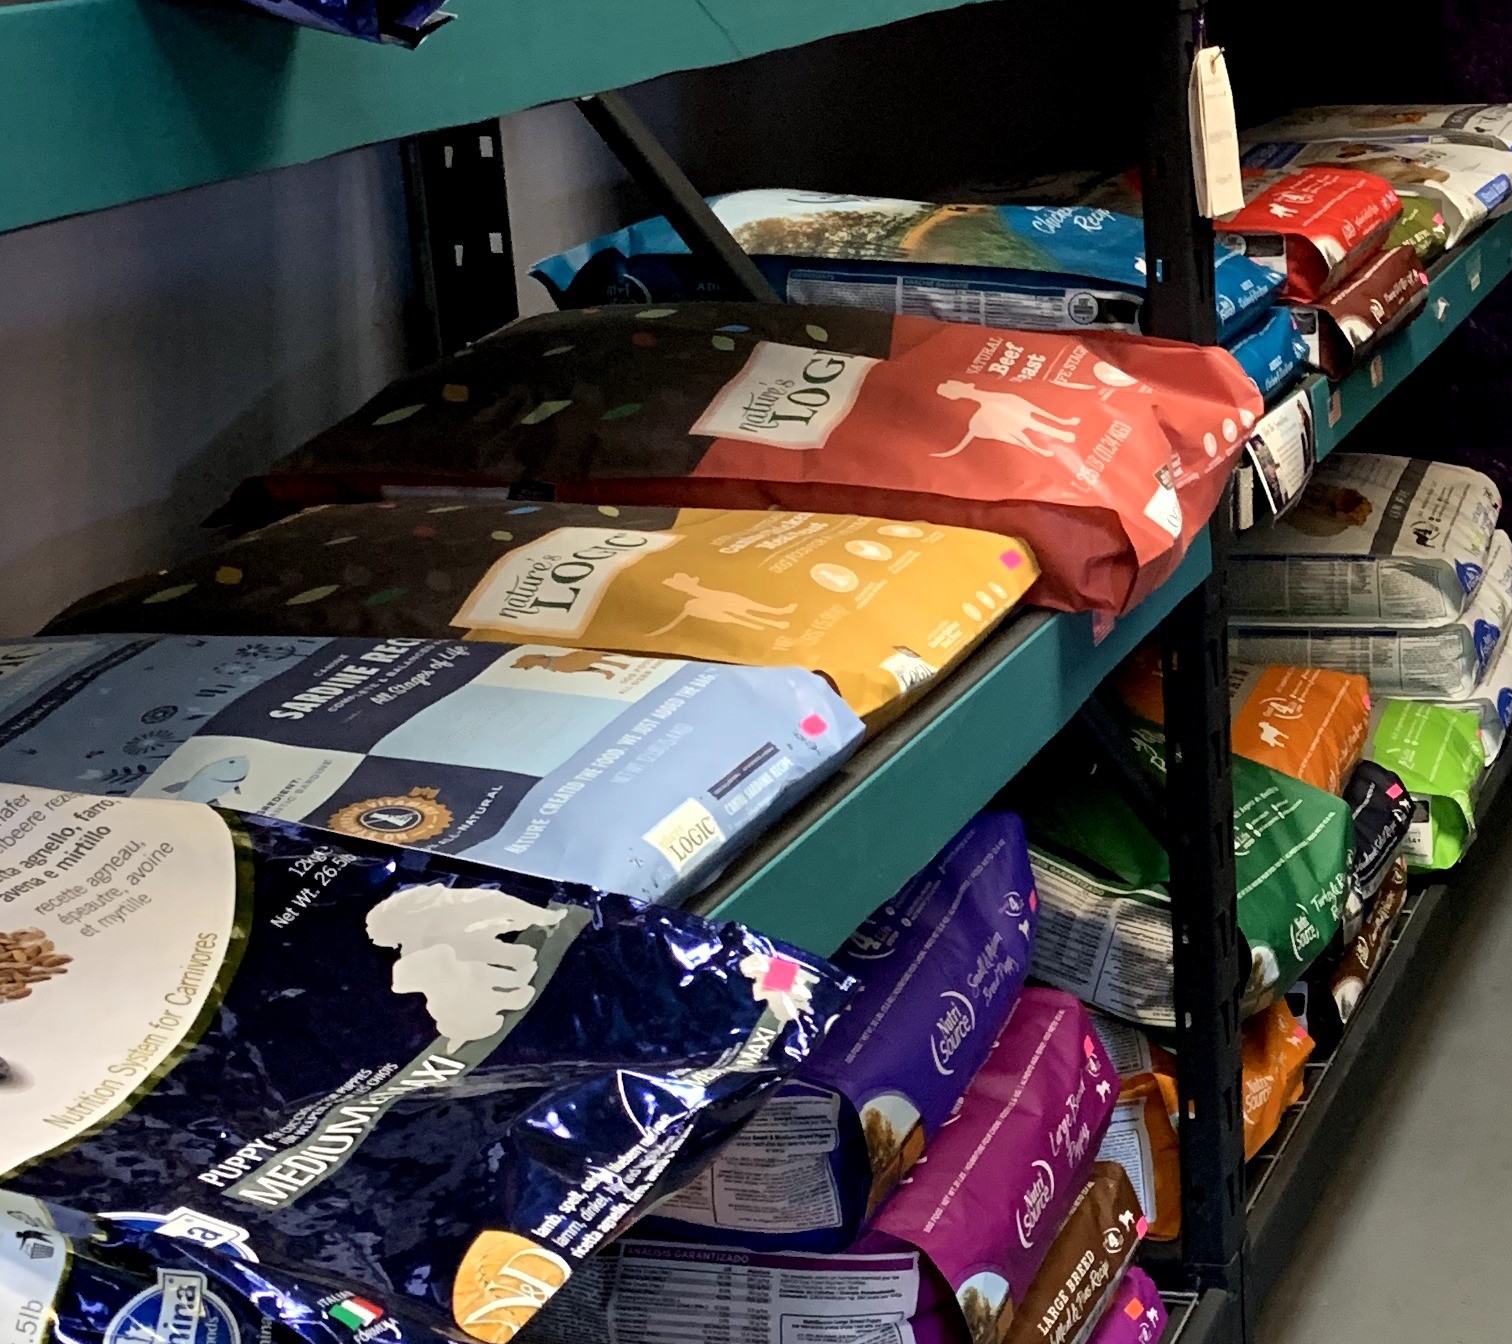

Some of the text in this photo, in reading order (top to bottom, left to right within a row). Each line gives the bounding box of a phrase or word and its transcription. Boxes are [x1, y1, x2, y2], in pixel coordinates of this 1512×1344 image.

[988, 341, 1024, 379] Beef
[739, 373, 796, 434] nature's
[497, 555, 557, 622] nature's
[270, 647, 378, 719] SARDINE
[388, 664, 437, 697] Stages
[539, 776, 587, 817] CREATED
[651, 693, 685, 723] ADDED
[0, 823, 113, 904] avena mirtillo
[24, 821, 85, 870] agnello,
[126, 840, 175, 884] avoine
[669, 815, 716, 862] LOGIC
[34, 839, 147, 916] recette agneau,
[270, 900, 300, 930] Net
[294, 879, 321, 913] Wt.
[78, 892, 153, 939] et myrtille
[42, 931, 219, 1131] Nutrition System for Carnivores
[198, 1137, 278, 1189] PUPPY
[238, 1102, 378, 1207] MEDIUM
[1022, 1184, 1051, 1238] Source
[1037, 1250, 1096, 1336] LARGE BREED
